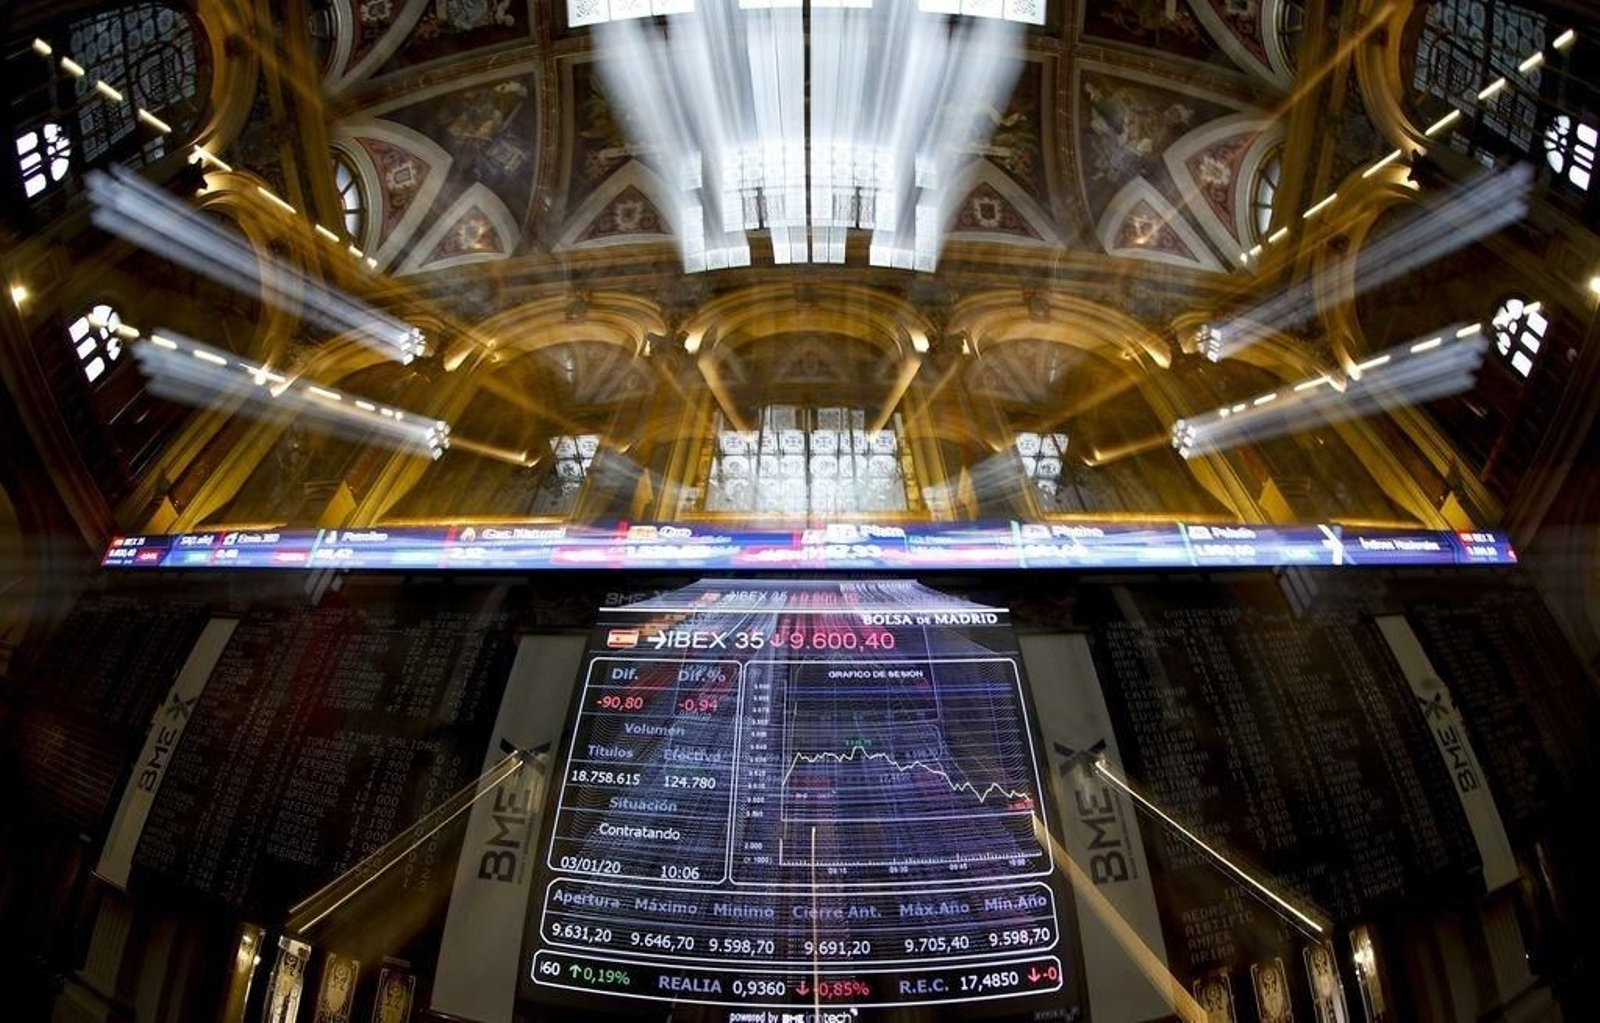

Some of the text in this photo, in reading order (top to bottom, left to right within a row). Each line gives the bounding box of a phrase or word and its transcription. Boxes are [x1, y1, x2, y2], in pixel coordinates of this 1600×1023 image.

[863, 614, 914, 626] BOLSA
[936, 614, 998, 626] MADRID
[668, 632, 895, 651] IBEX 35 9.600,40
[612, 667, 638, 680] Dif.
[597, 696, 718, 713] -90,80 -0,94
[624, 722, 686, 736] Volumen
[571, 770, 716, 790] 18.758.615 124.780
[609, 798, 678, 813] Situación
[600, 823, 680, 840] Contratando
[560, 856, 700, 880] 03/01/20 10:06
[554, 890, 620, 910] Apertura
[634, 896, 698, 914] Máximo
[792, 906, 842, 920] Cierre
[848, 906, 882, 920] Ant.
[900, 902, 970, 917] Máx.Año
[552, 923, 1050, 956] 9.631,20 9.646,70 9.598,70 9.691,20 9.705,40 9.598,70
[583, 966, 631, 985] 0,19%
[658, 976, 723, 994] REALIA
[732, 980, 786, 998] 0,9360
[900, 978, 950, 994] R.E.C.
[960, 971, 1018, 992] 17,4850
